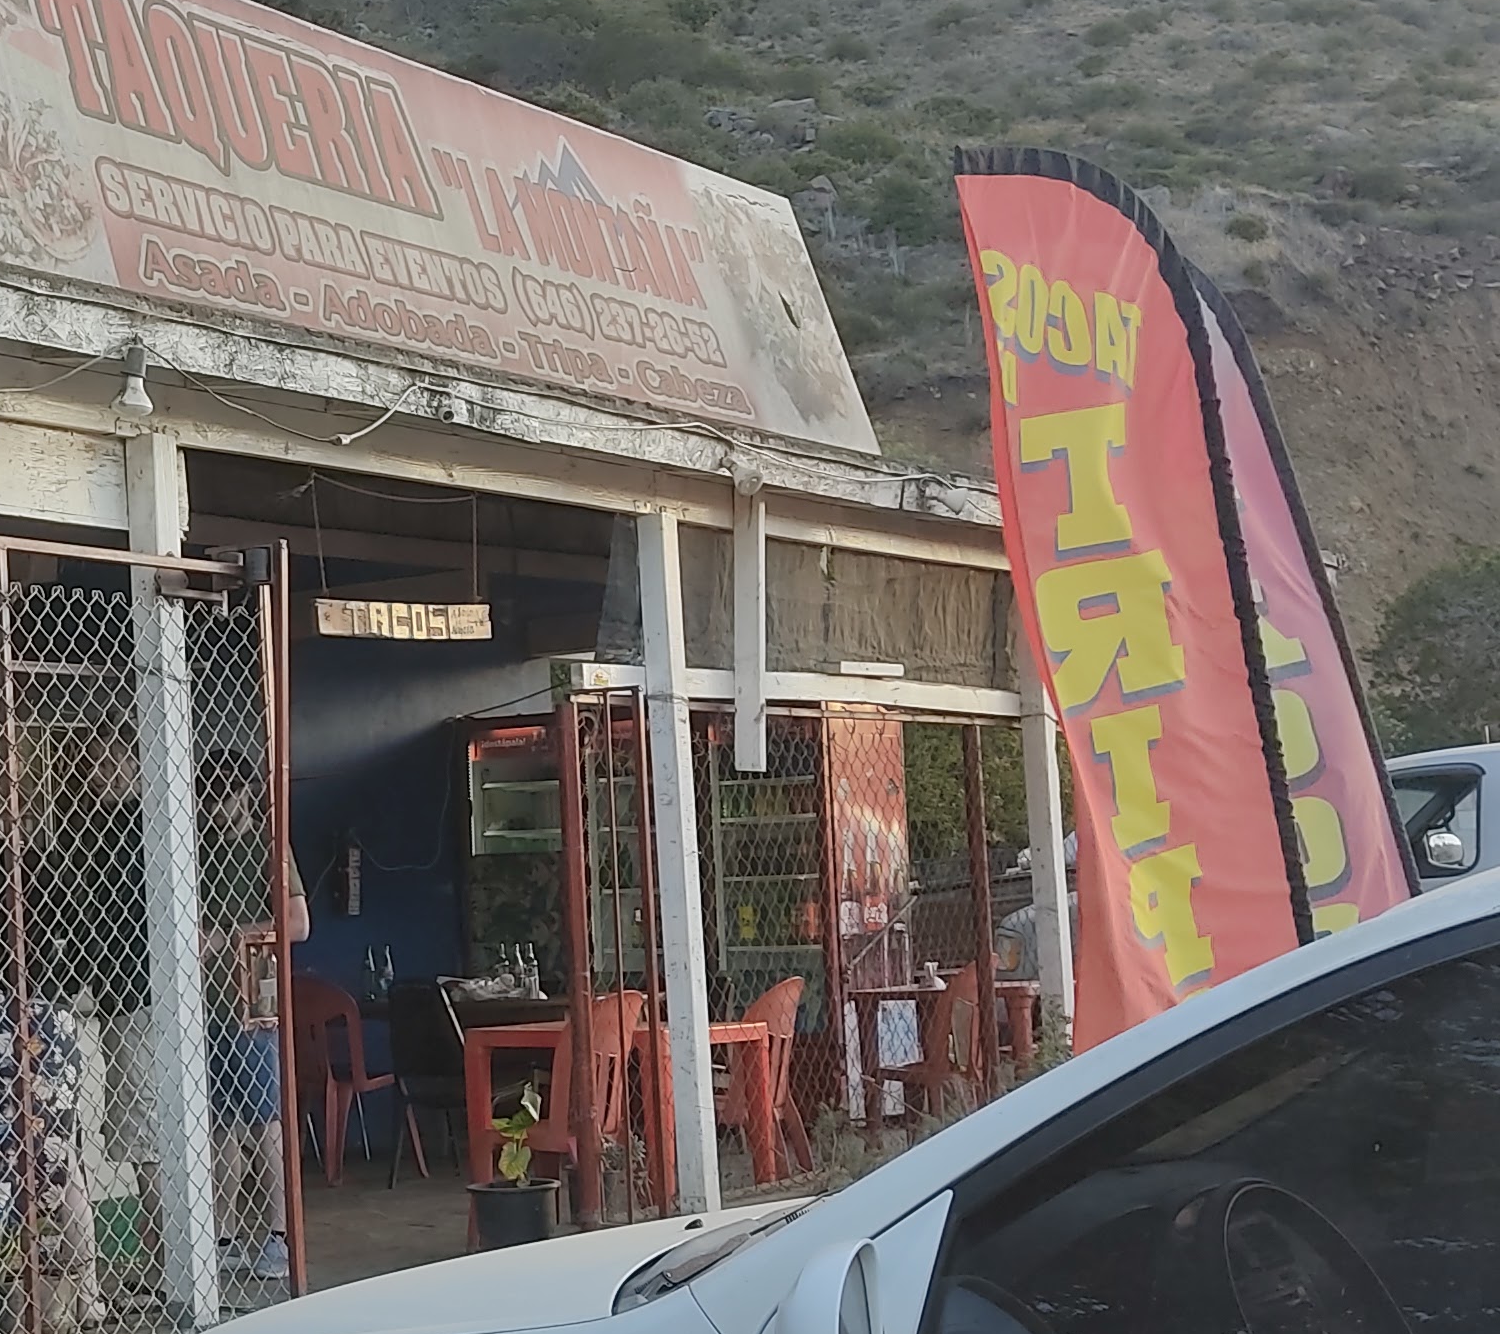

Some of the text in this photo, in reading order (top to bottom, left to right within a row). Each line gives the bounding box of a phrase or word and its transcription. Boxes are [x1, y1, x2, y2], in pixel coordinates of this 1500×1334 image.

[95, 157, 727, 368] SERVICIO PARA EVENTOS (646) 237-26-52
[144, 239, 287, 312] Asada
[322, 284, 498, 359] Adobada
[518, 331, 614, 384] Tripa
[637, 360, 752, 415] Cabeza
[343, 601, 449, 639] TACOS
